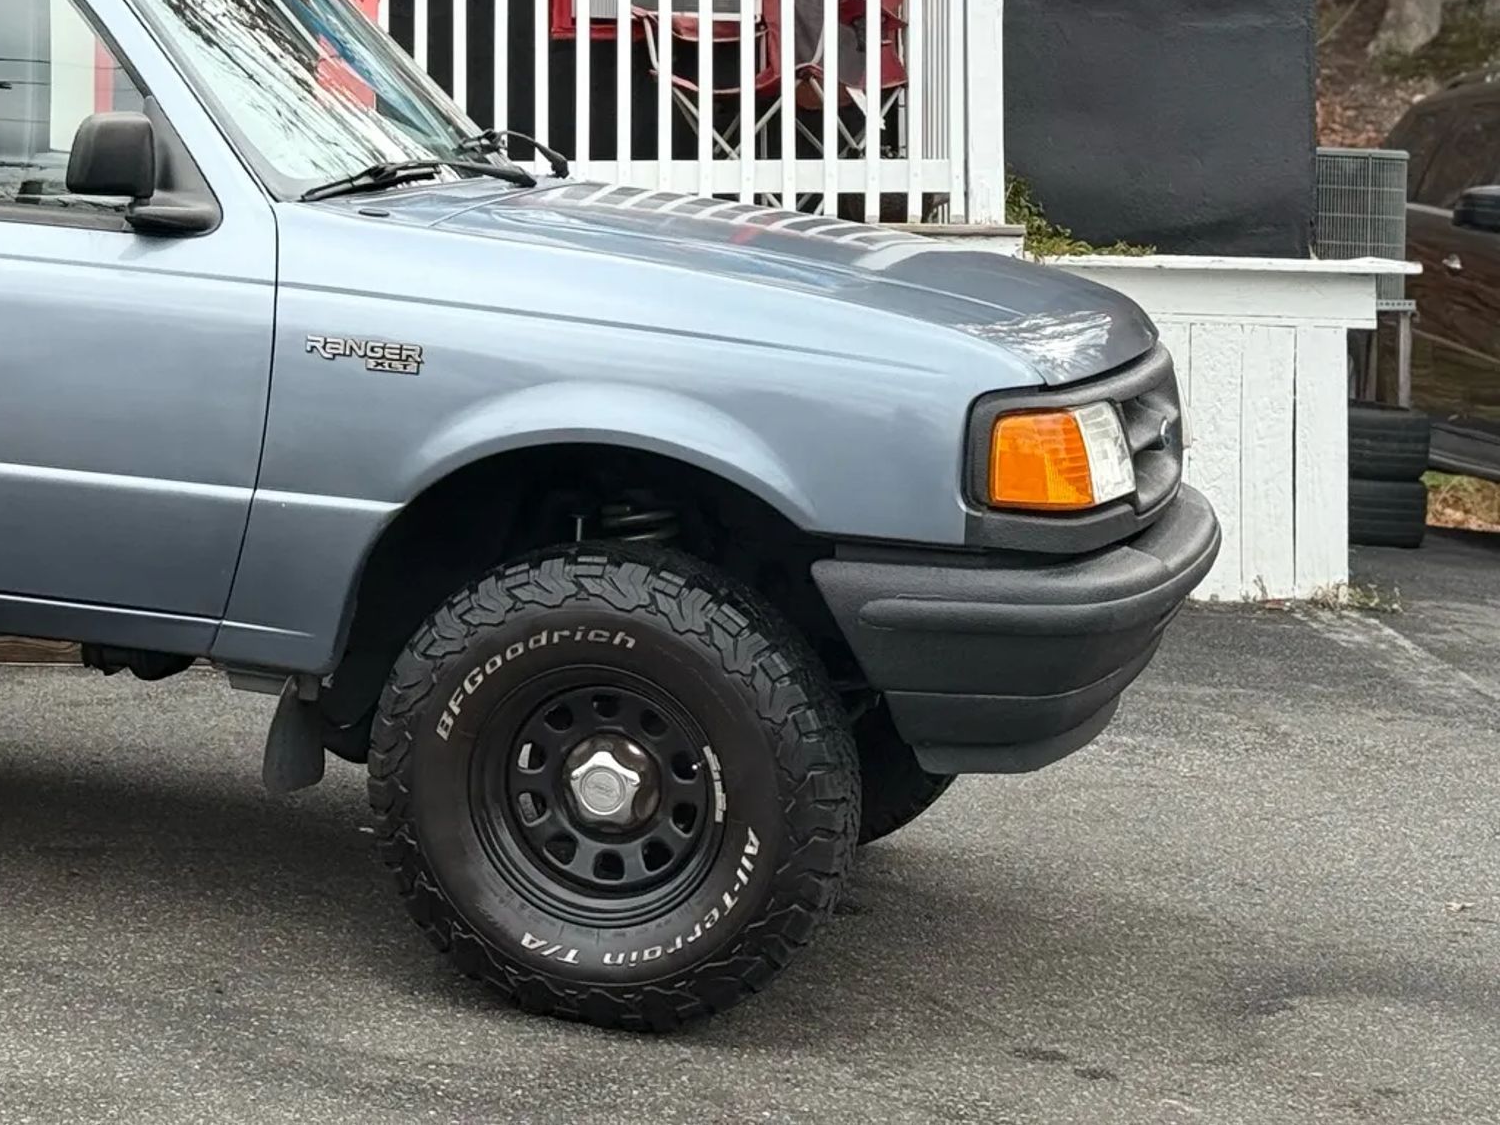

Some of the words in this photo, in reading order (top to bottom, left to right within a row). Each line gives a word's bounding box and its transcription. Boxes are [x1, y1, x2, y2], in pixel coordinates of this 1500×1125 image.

[305, 335, 424, 363] RANGER
[373, 361, 412, 371] XLT
[436, 626, 637, 741] BFGoodrich
[602, 827, 762, 967] All-Terrain
[520, 931, 580, 965] T/A
